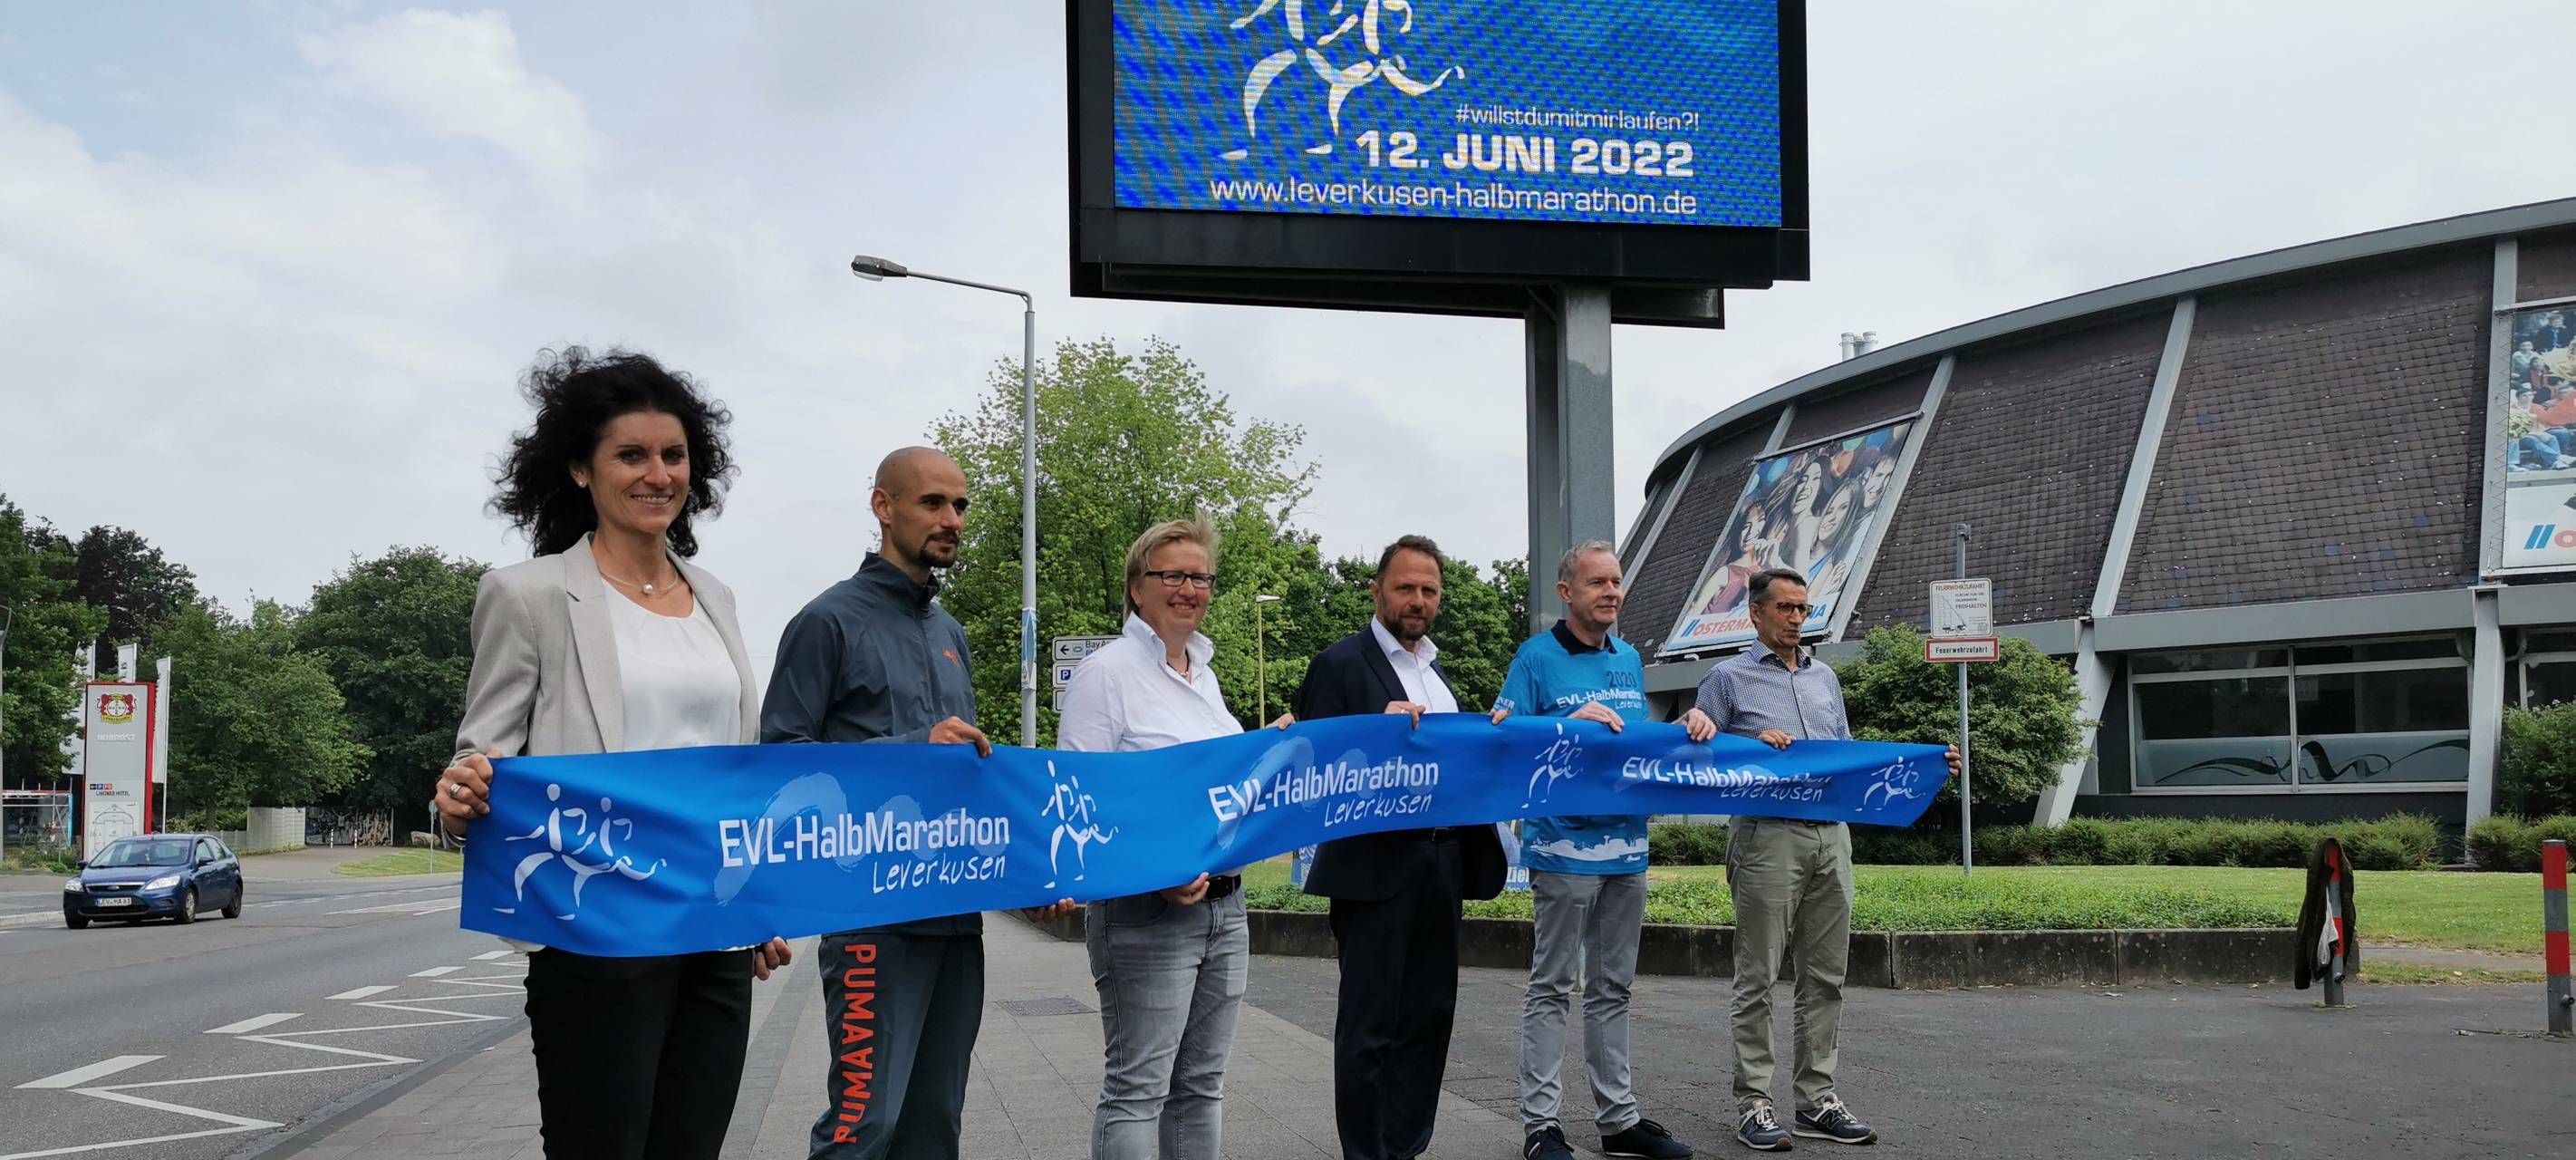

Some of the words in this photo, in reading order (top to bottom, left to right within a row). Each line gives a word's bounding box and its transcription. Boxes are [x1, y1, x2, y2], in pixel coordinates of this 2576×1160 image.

[1455, 104, 1700, 132] #willstdumitmirlaufen?!
[1356, 130, 1429, 169] 12.
[1442, 132, 1556, 172] JUNI
[1571, 136, 1694, 178] 2022
[1210, 176, 1697, 215] www.leverkusen-halbmarathon.de
[1693, 618, 1754, 636] OSTERMA
[1935, 646, 1988, 654] Feuerwehrzufahrt
[1606, 671, 1637, 688] 2020
[1208, 756, 1439, 822] EVL-HalbMarathon
[1324, 792, 1433, 827] Leverkusen
[719, 807, 1010, 868] EVL-HalbMarathon
[873, 853, 1006, 894] Leverkusen
[841, 943, 877, 1045] PUMA
